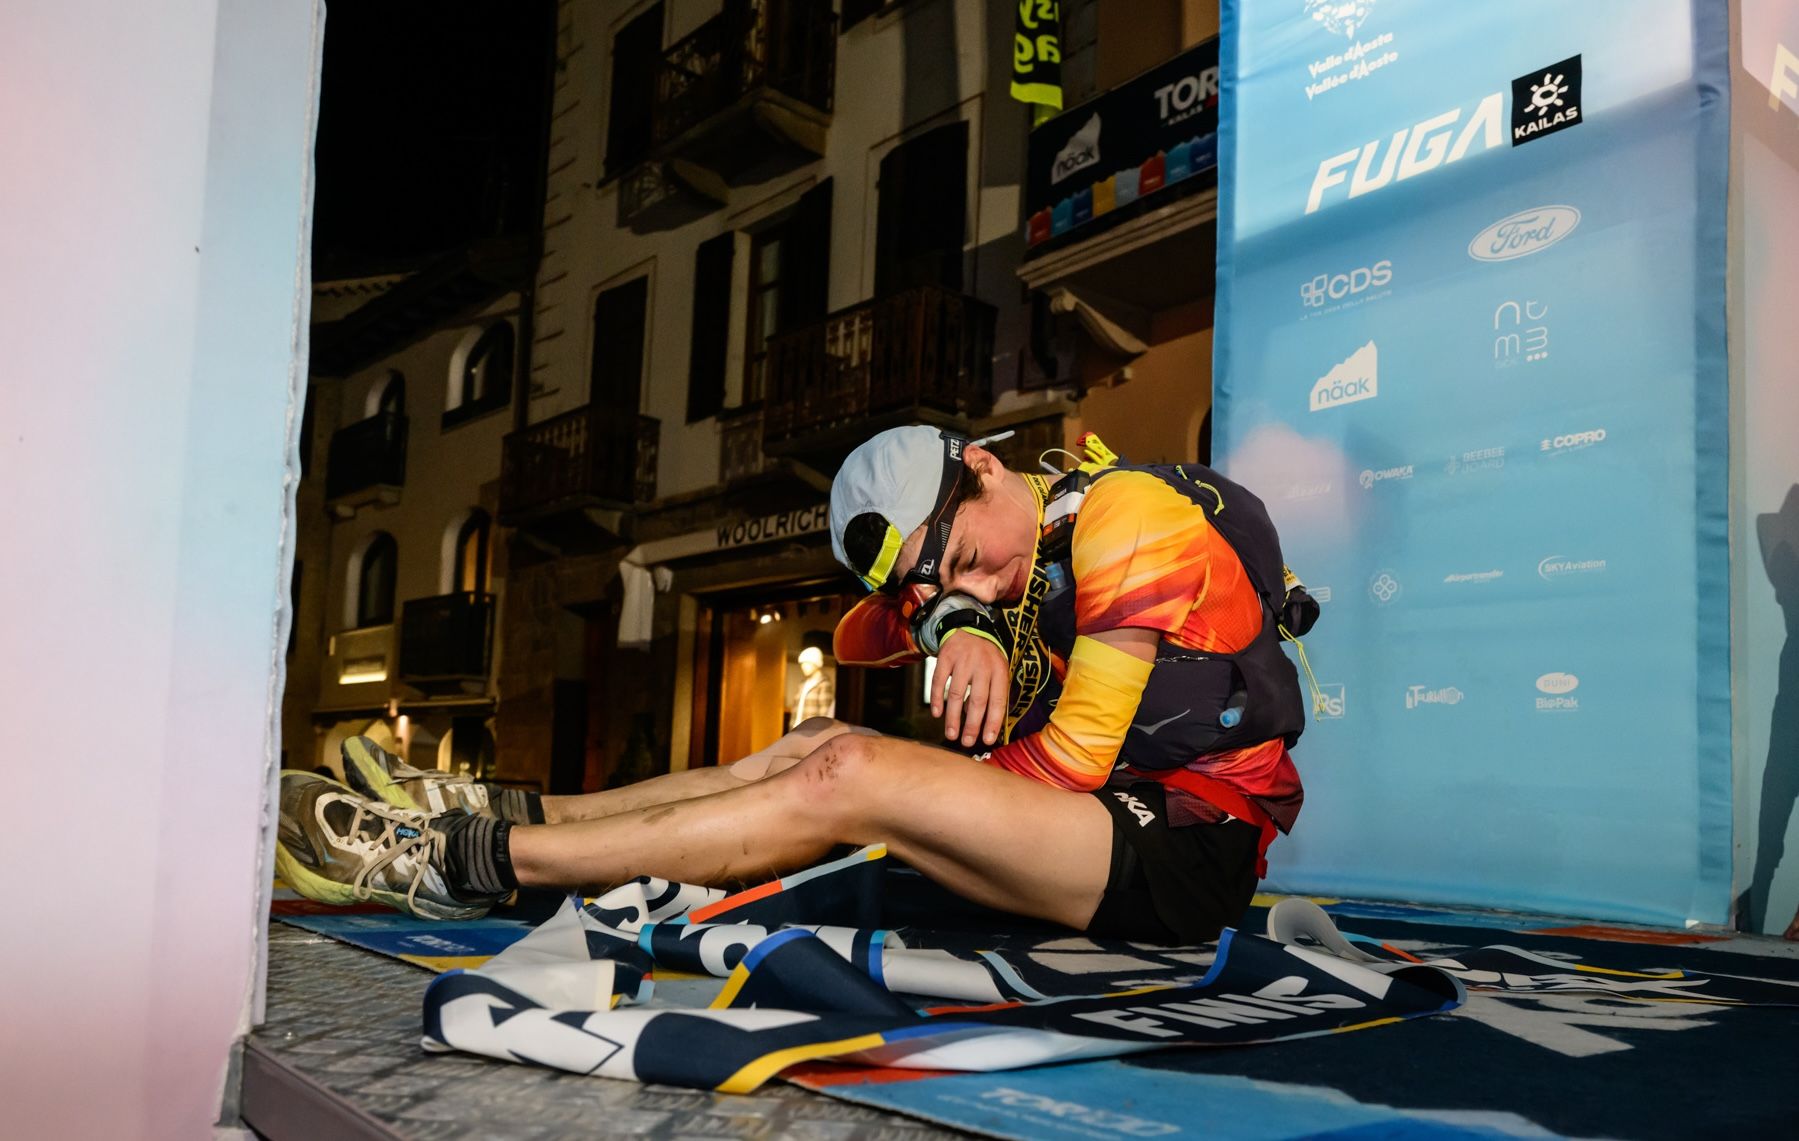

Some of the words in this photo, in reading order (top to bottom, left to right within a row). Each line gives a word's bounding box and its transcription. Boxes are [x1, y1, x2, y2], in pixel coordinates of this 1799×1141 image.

[1308, 55, 1343, 79] Valle
[1515, 106, 1579, 139] KAILAS
[1490, 216, 1556, 254] Ford
[1328, 260, 1392, 299] CDS
[1318, 377, 1370, 404] näak
[1553, 428, 1606, 449] COPRO
[717, 505, 829, 547] WOOLRICH
